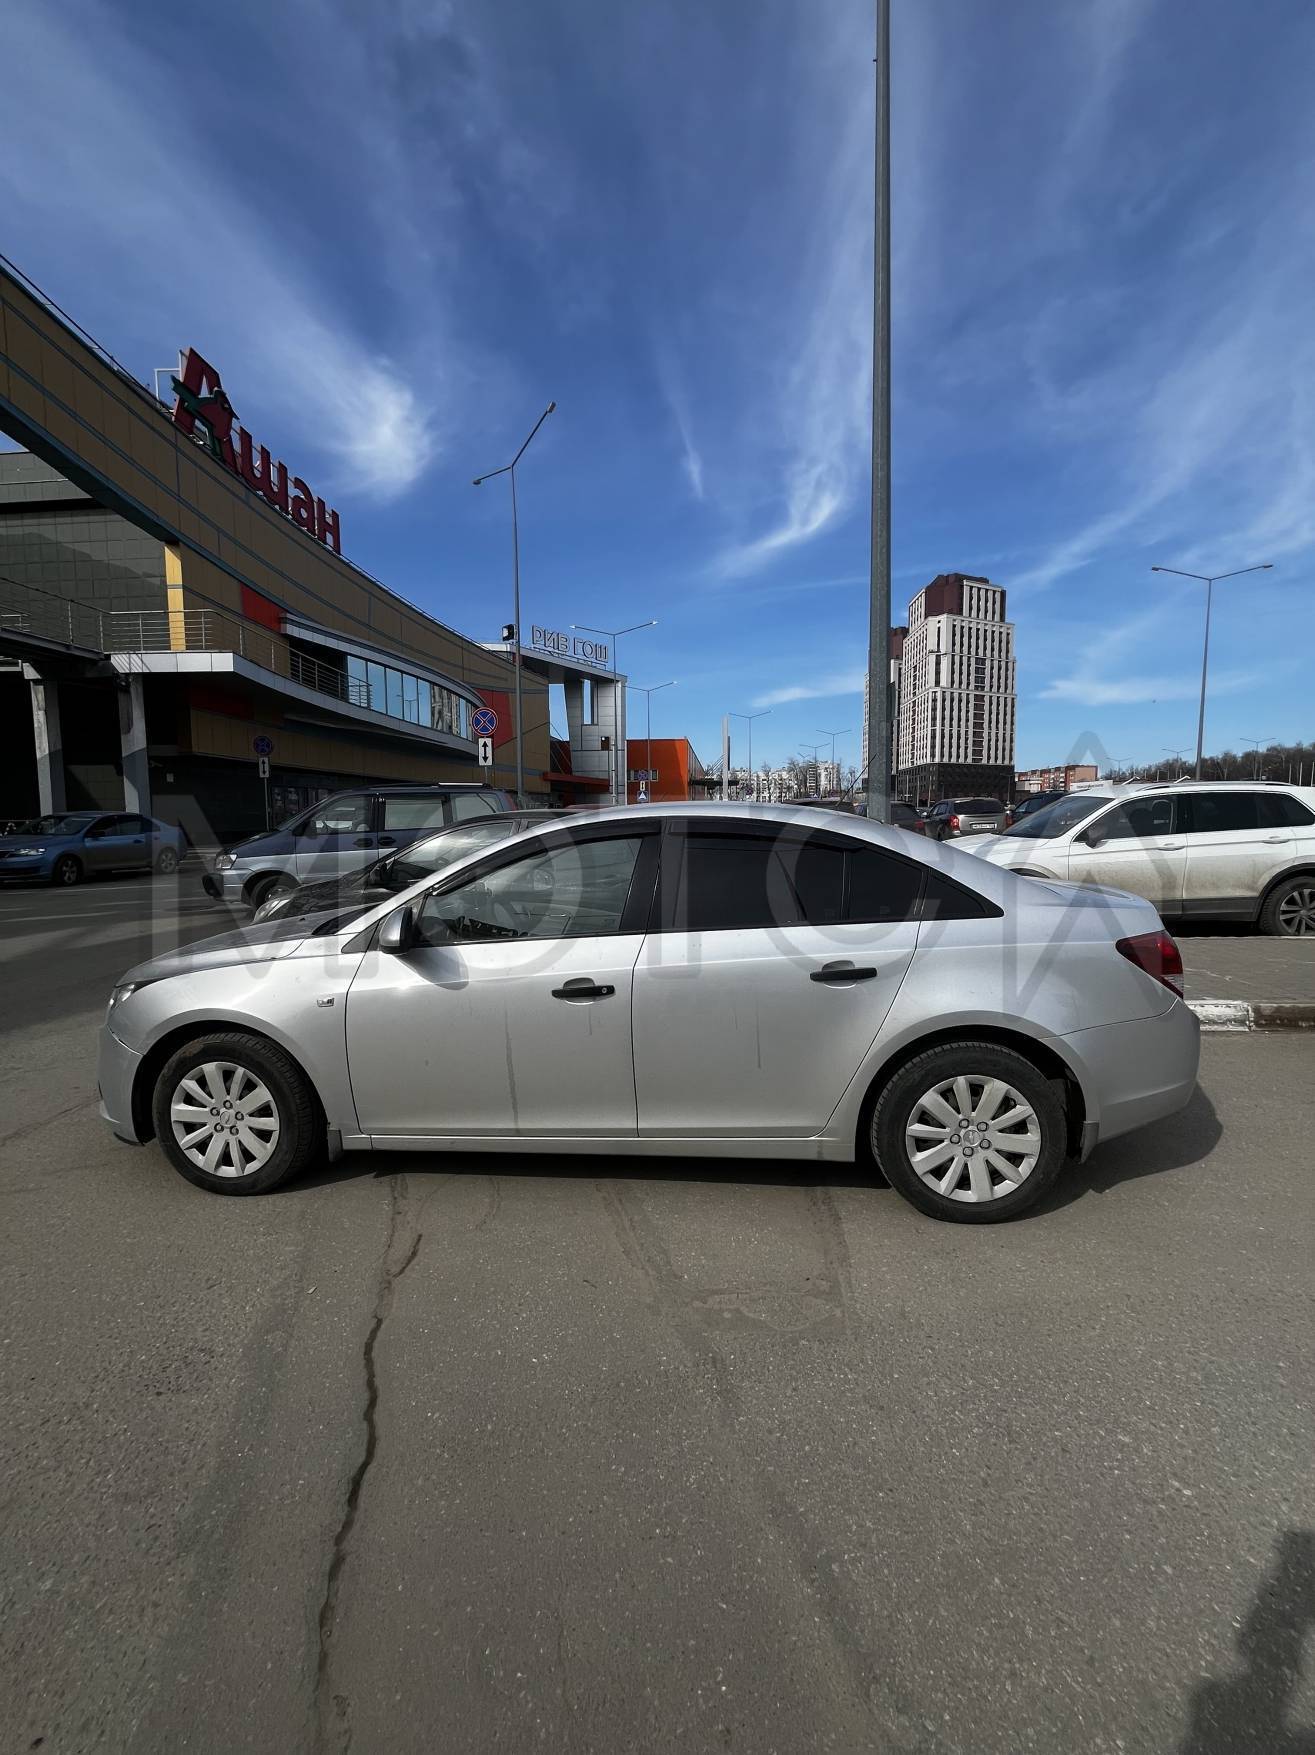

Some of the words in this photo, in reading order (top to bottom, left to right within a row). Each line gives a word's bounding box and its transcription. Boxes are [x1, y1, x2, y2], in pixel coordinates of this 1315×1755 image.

[172, 347, 342, 556] Ашан
[531, 624, 570, 655] РИВ
[573, 636, 609, 663] ГОШ
